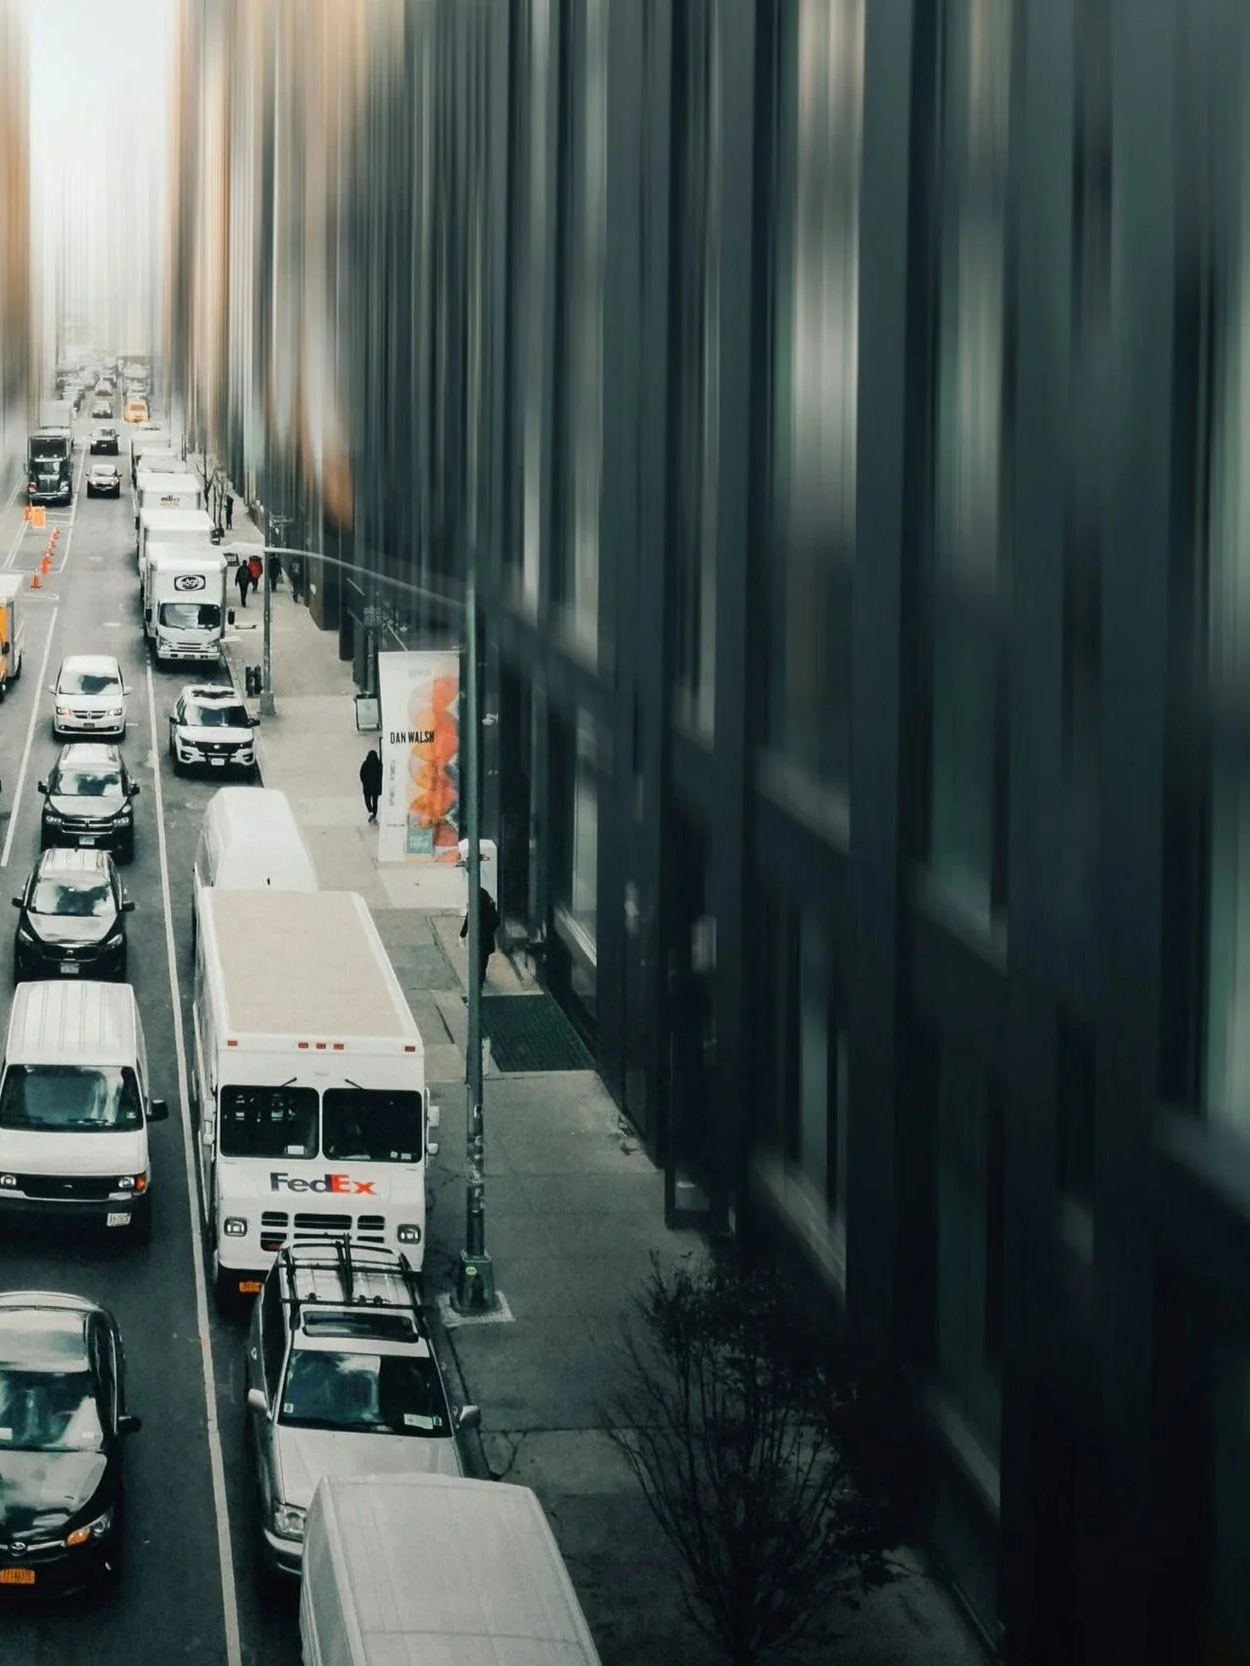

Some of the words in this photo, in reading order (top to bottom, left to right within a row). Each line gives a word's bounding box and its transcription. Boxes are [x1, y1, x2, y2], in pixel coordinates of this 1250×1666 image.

[390, 732, 407, 744] DAN
[408, 730, 435, 744] WALSH
[270, 1172, 378, 1196] FedEx
